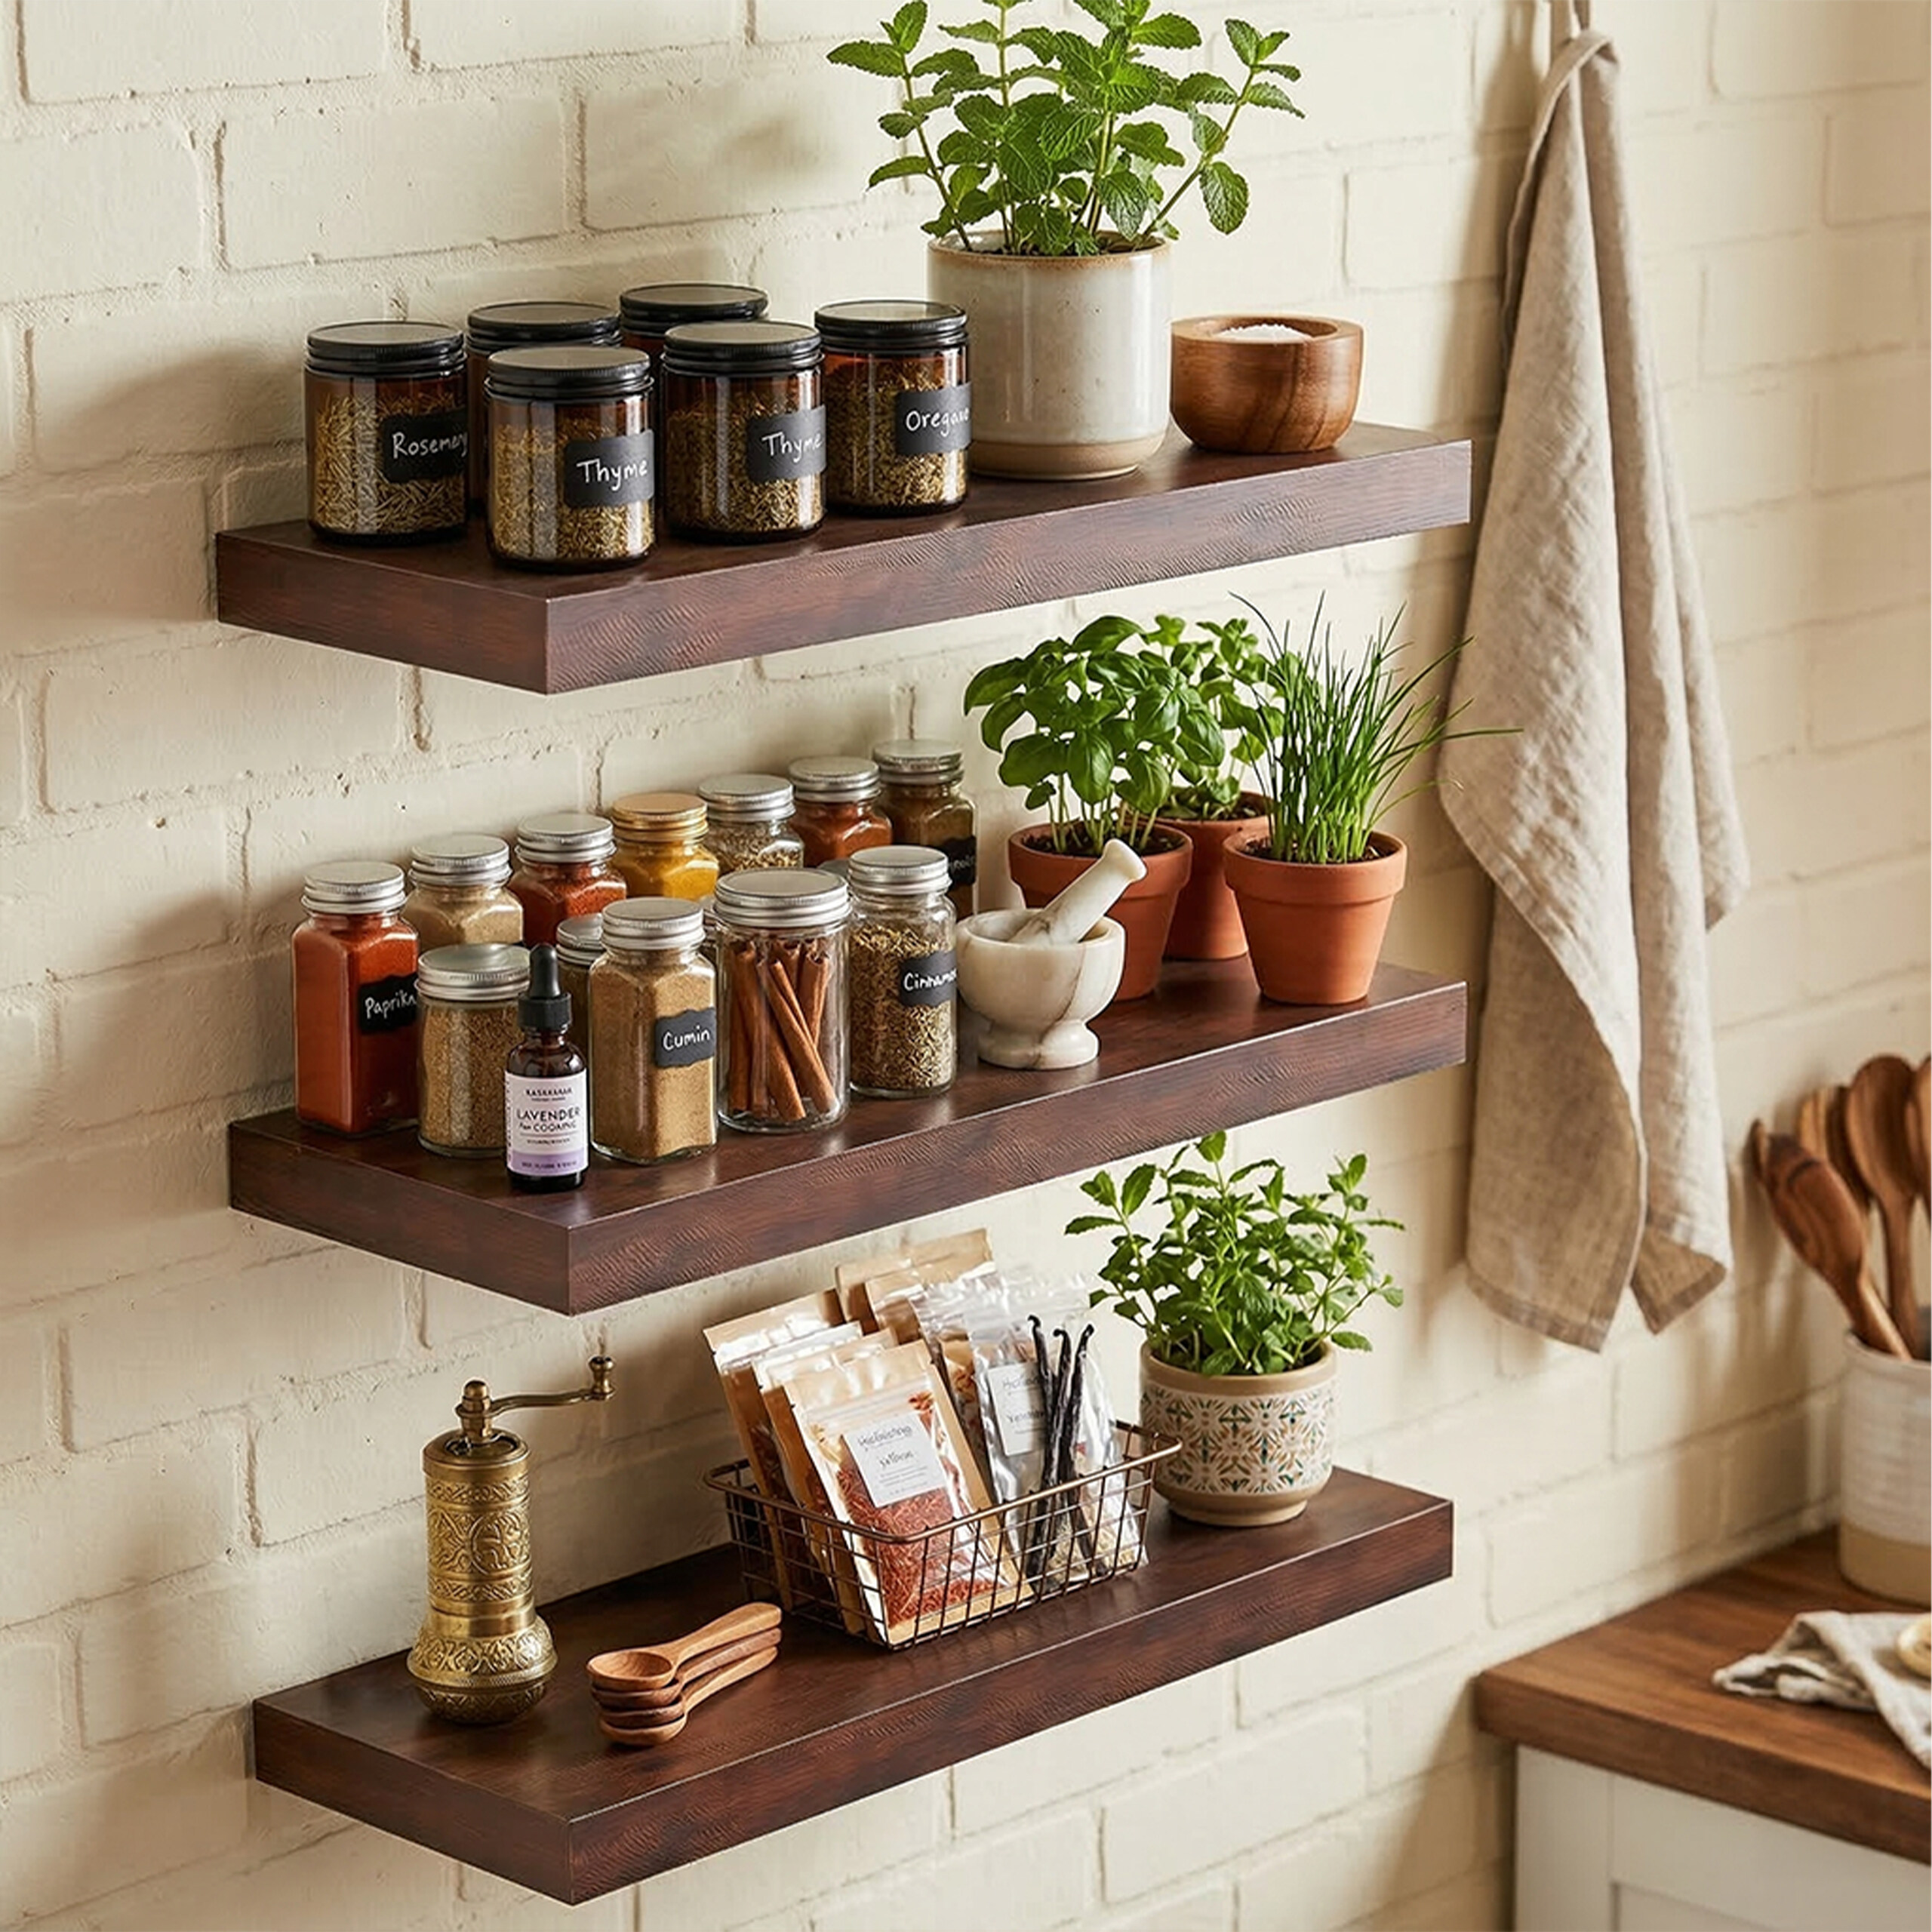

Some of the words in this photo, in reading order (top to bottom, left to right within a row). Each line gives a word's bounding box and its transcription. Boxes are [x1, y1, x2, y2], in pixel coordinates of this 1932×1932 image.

[761, 431, 823, 463] Thyme
[576, 458, 648, 491] Thyme
[663, 1025, 710, 1051] Cumin
[516, 1106, 580, 1122] LAVENDER
